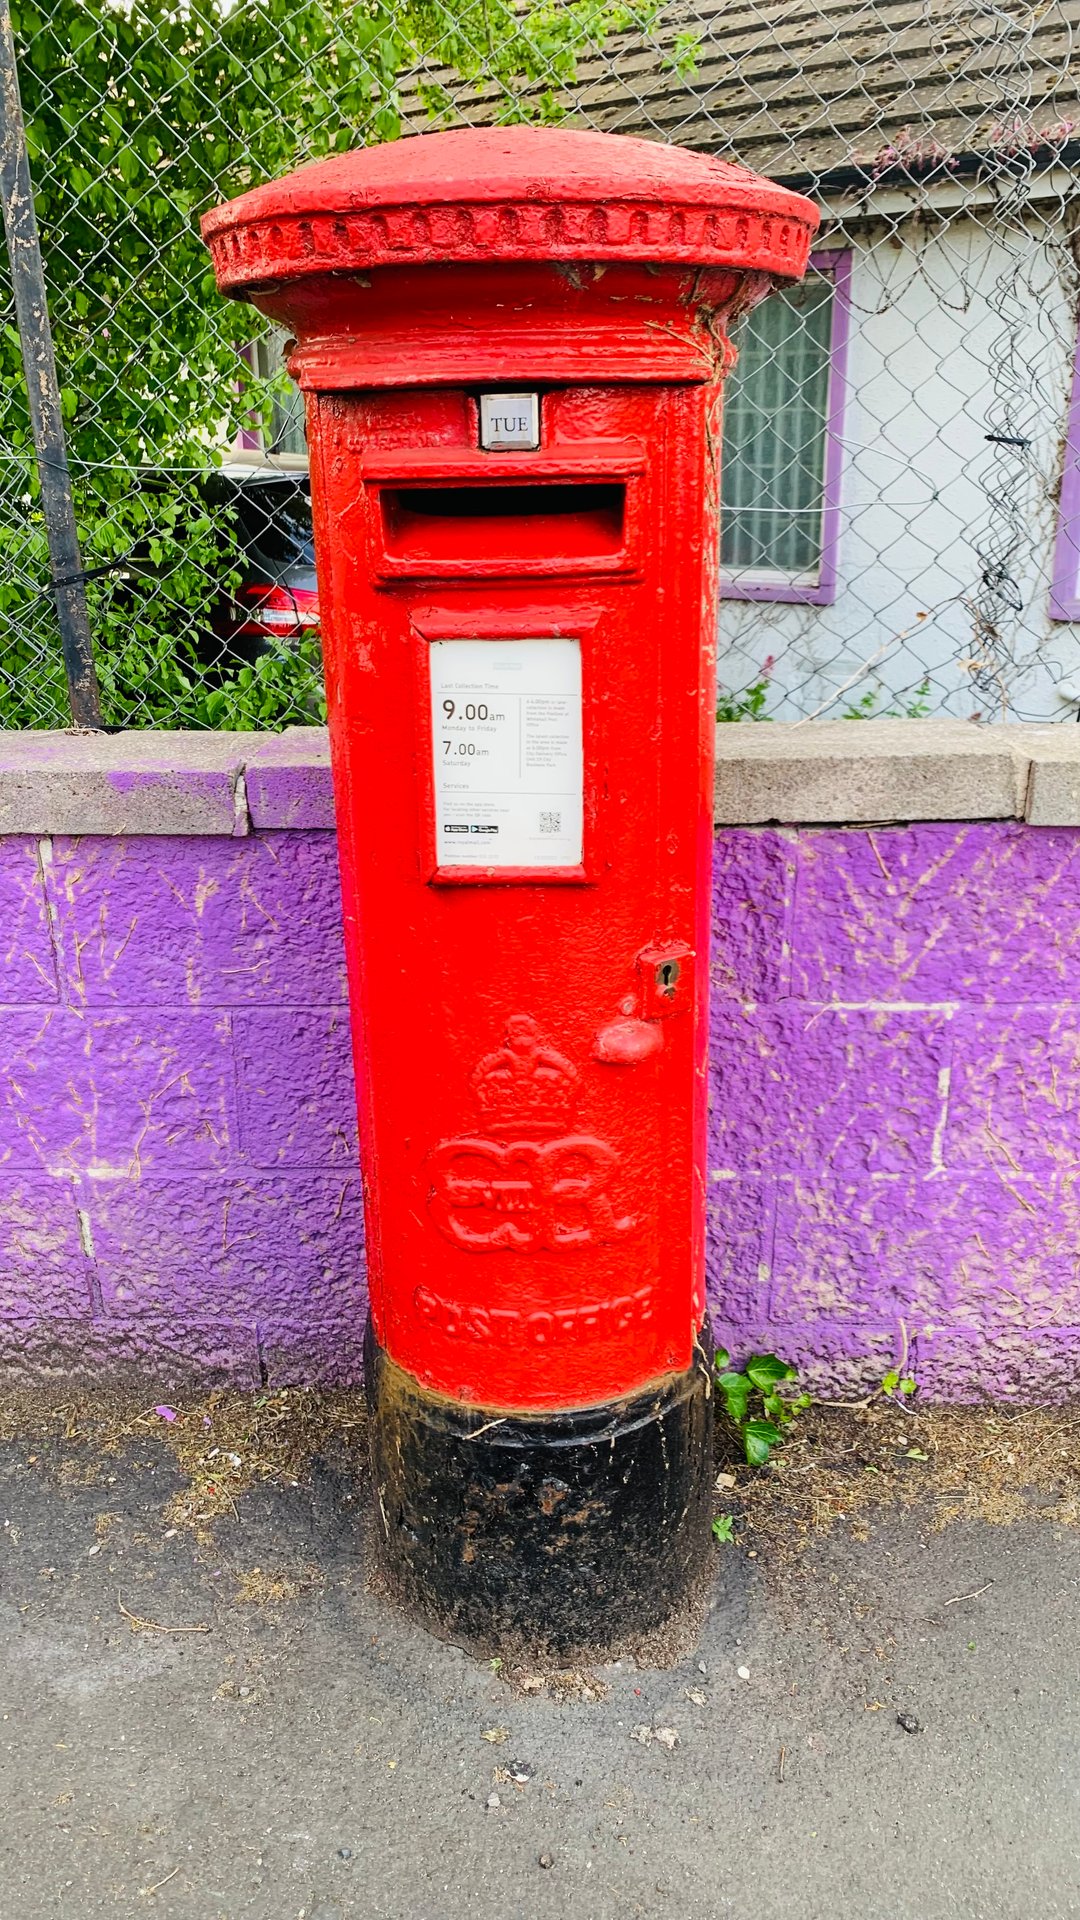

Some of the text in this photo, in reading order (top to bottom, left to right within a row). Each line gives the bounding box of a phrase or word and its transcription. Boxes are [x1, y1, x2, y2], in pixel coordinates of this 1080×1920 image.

[490, 417, 529, 432] TUE
[455, 682, 483, 690] Collection
[442, 699, 505, 721] 9.00am
[442, 724, 466, 732] Monday
[477, 725, 497, 733] Friday
[442, 740, 490, 756] 7.00am
[442, 759, 471, 768] Saturday
[443, 782, 469, 790] Services
[413, 1283, 655, 1344] POST OFFICE
